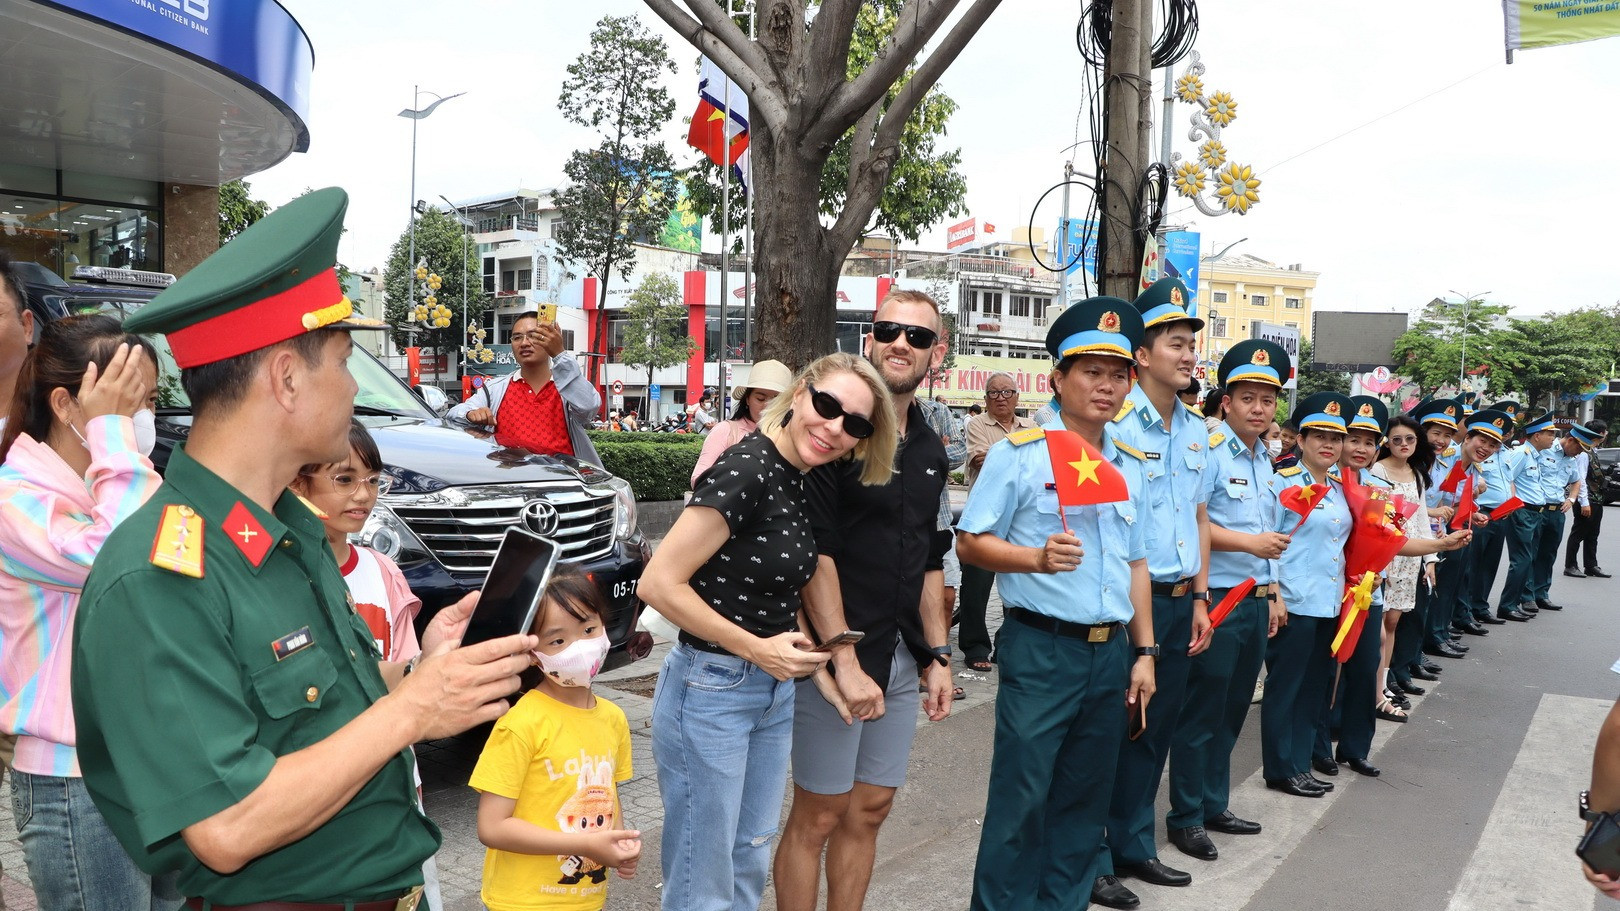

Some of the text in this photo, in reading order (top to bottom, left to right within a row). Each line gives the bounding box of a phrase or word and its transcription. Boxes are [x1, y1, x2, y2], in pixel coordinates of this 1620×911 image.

[1533, 4, 1543, 12] 50
[159, 7, 189, 26] CITIZEN
[191, 21, 209, 36] BANK
[957, 365, 992, 391] KÍN
[613, 579, 640, 598] 05-7
[540, 884, 567, 895] Have
